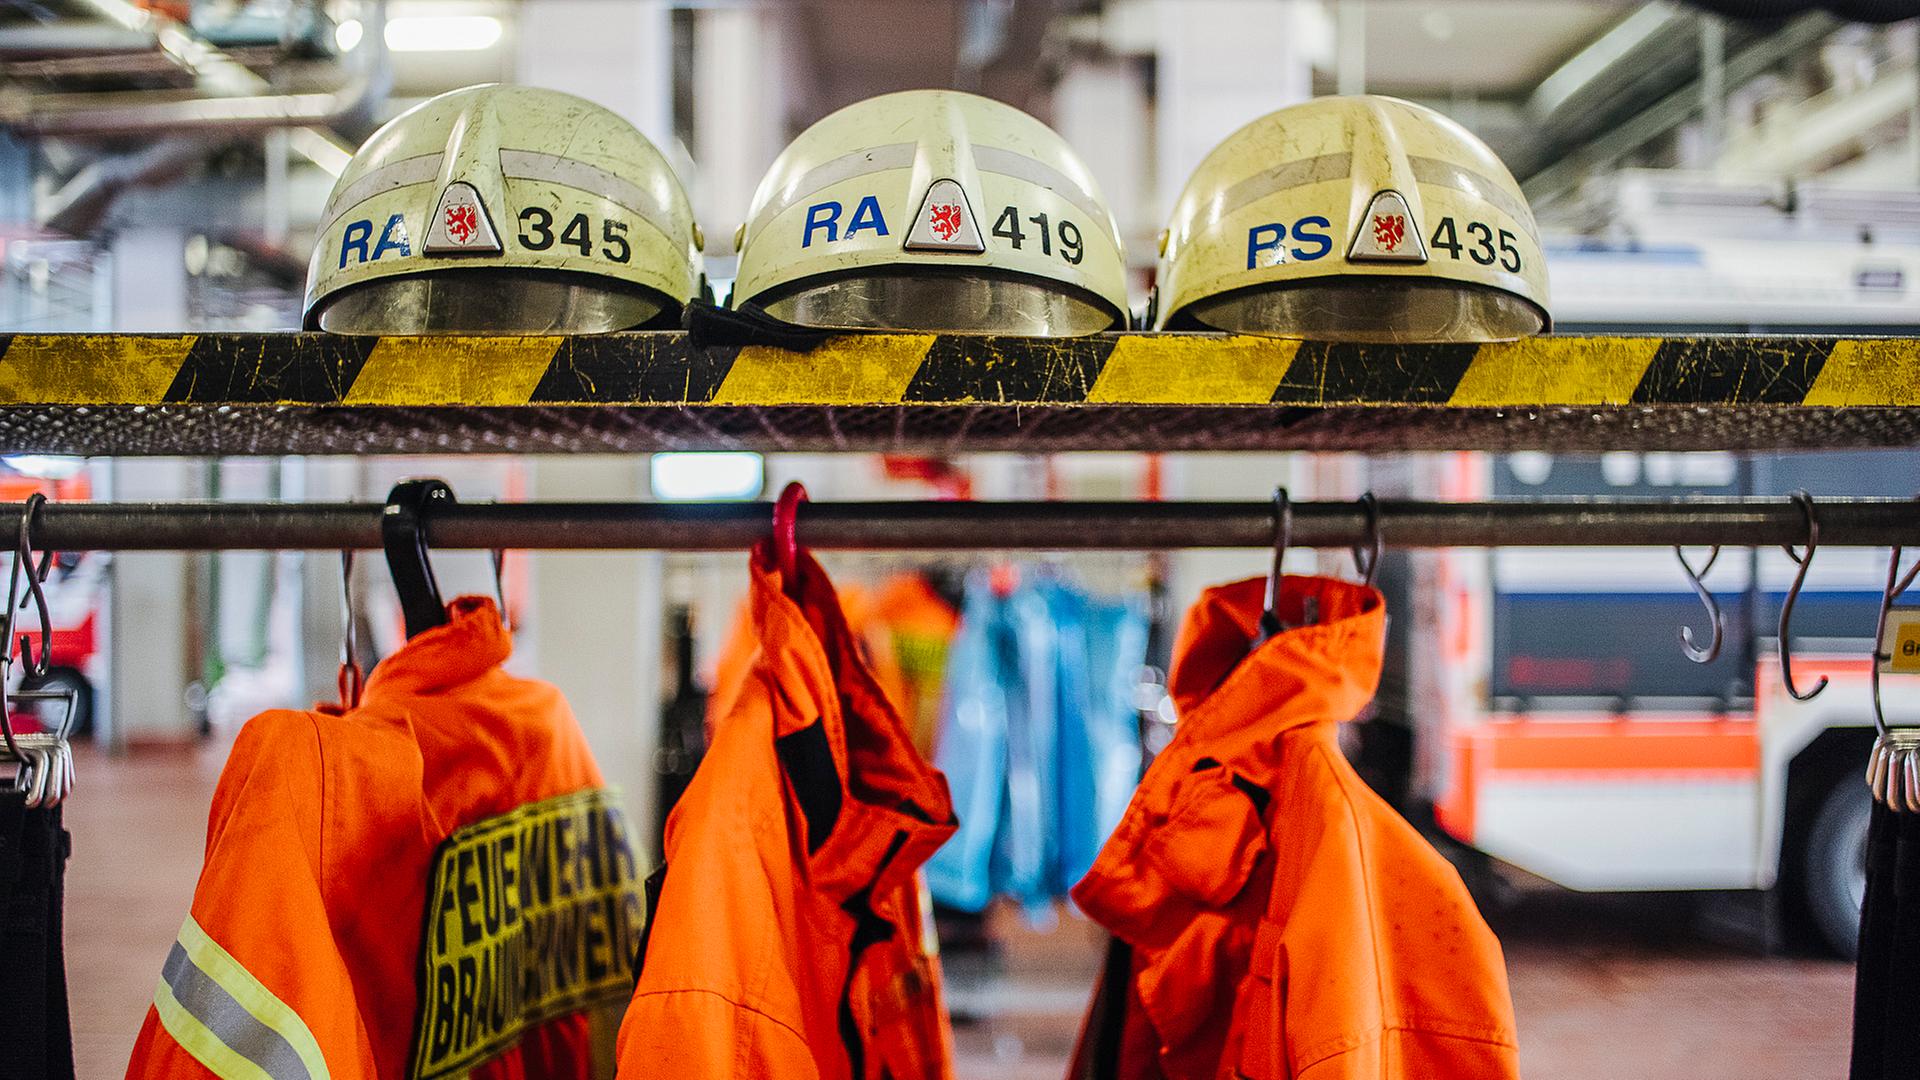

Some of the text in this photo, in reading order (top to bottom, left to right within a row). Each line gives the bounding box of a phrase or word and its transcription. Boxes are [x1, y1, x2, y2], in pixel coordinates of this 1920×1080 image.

[339, 206, 632, 269] RA 345
[801, 195, 1084, 265] RA 419
[1430, 216, 1521, 273] 435
